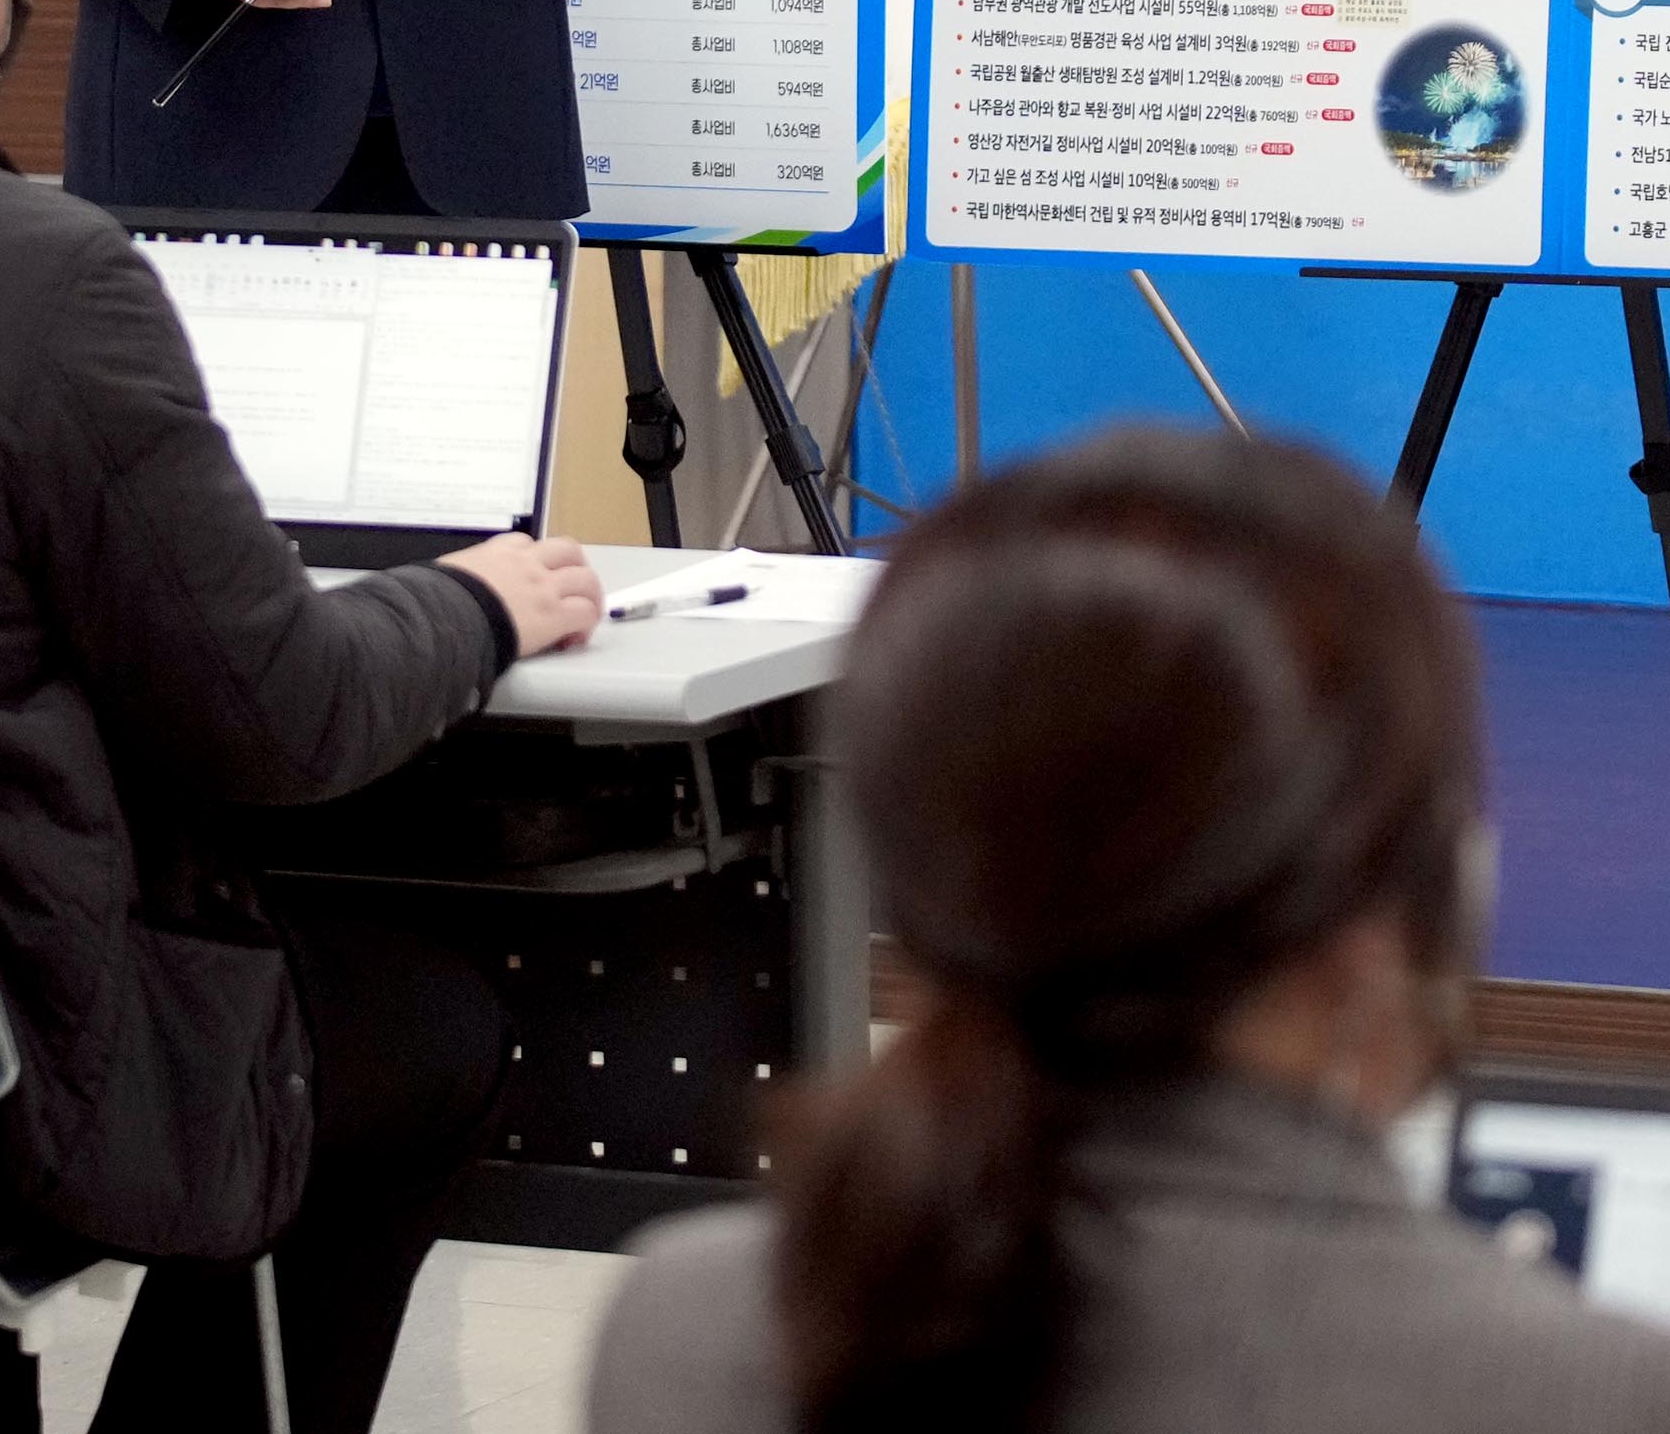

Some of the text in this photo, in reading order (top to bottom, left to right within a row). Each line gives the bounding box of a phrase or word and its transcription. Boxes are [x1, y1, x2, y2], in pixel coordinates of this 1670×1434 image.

[773, 40, 823, 55] 1,108억원
[1636, 34, 1660, 51] 국립
[580, 73, 618, 91] 21억원
[778, 82, 823, 97] 594억원
[767, 123, 820, 138] 1,636억원
[968, 134, 1002, 150] 영산강
[1006, 135, 1052, 152] 자전거길
[1057, 136, 1103, 153] 정비사업
[1107, 137, 1142, 154] 시설비
[778, 165, 823, 180] 320억원
